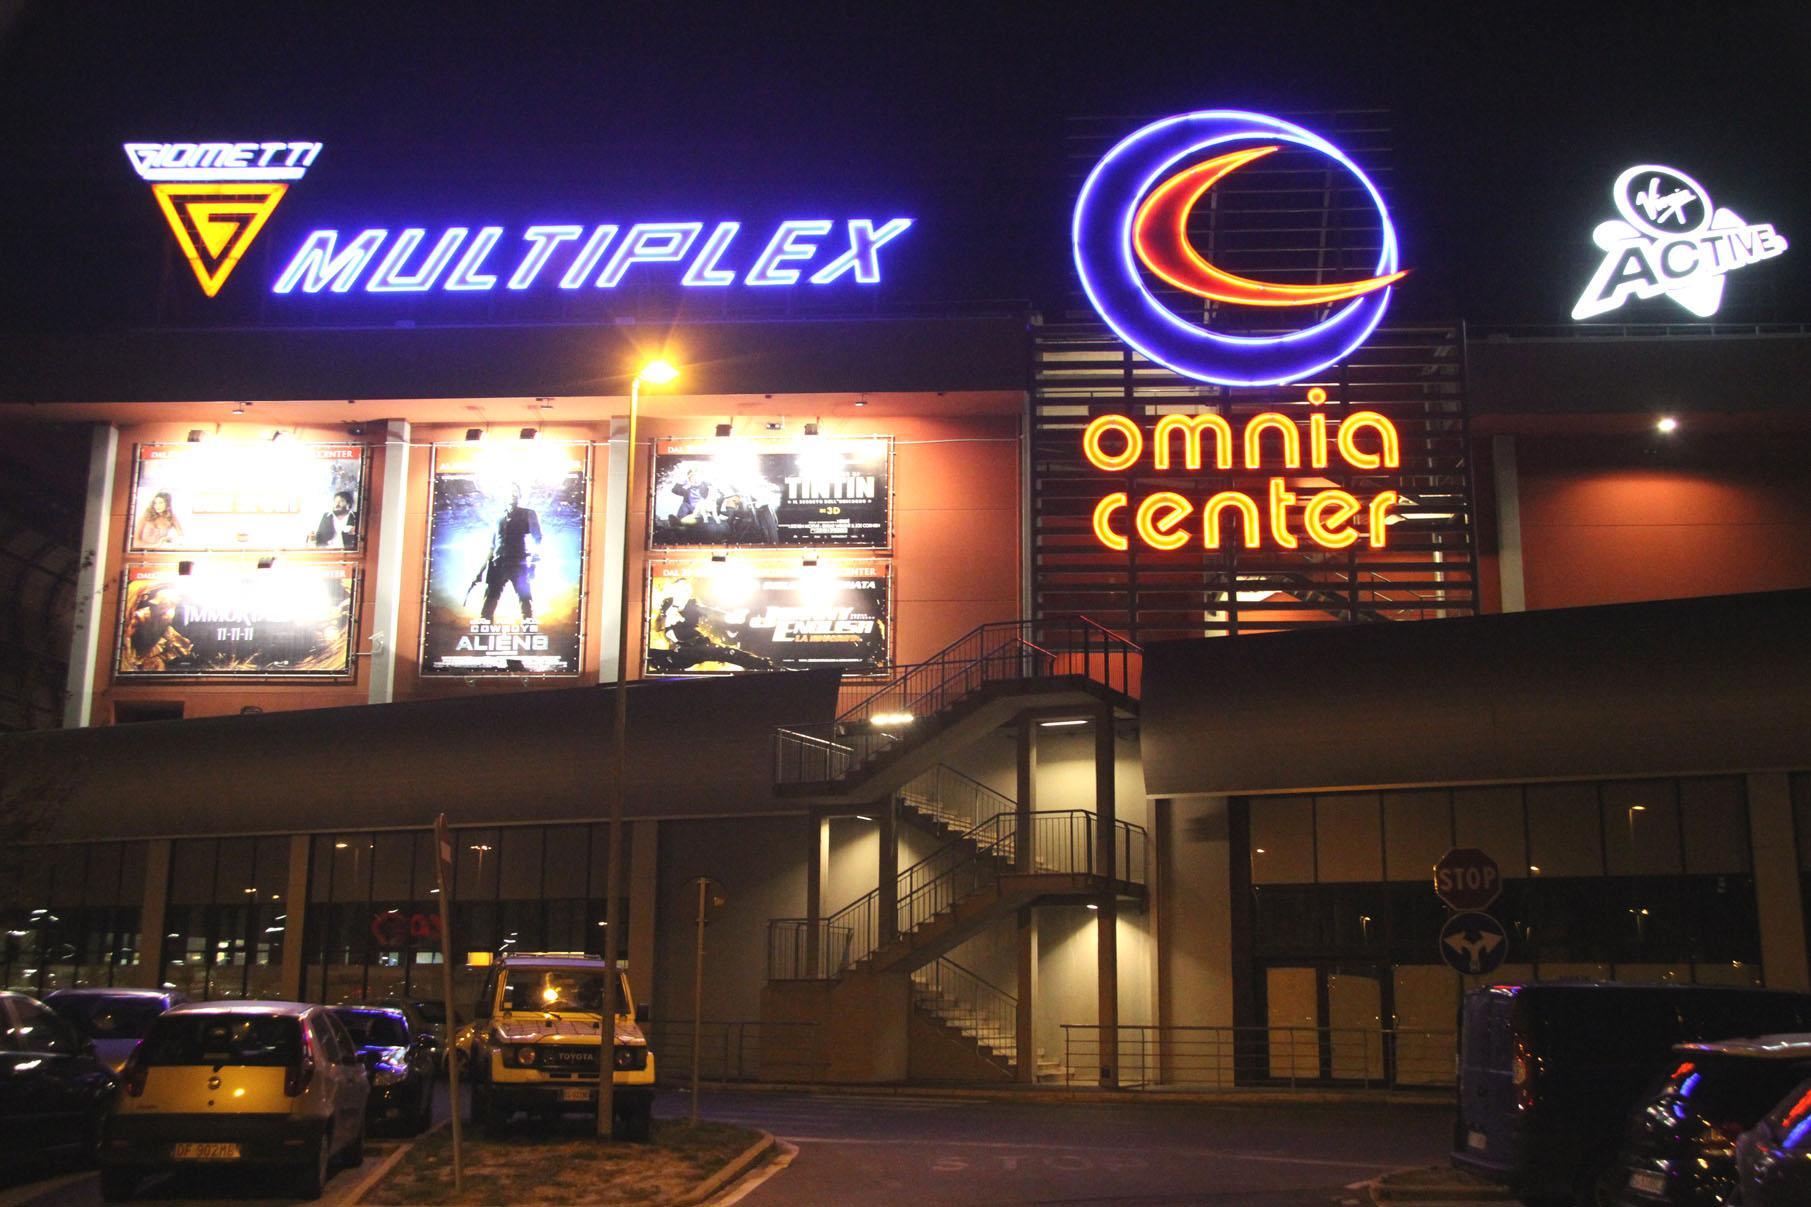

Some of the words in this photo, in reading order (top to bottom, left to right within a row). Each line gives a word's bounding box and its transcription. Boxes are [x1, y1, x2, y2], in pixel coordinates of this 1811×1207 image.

[123, 142, 323, 178] GIOMETTI
[273, 216, 917, 294] MULTIPLEX
[1585, 226, 1782, 307] ACTIVE
[1083, 387, 1400, 471] omnia
[784, 476, 875, 499] TINTIN
[1092, 477, 1398, 551] center
[1439, 867, 1496, 891] STOP
[559, 1053, 593, 1062] TOYOTA
